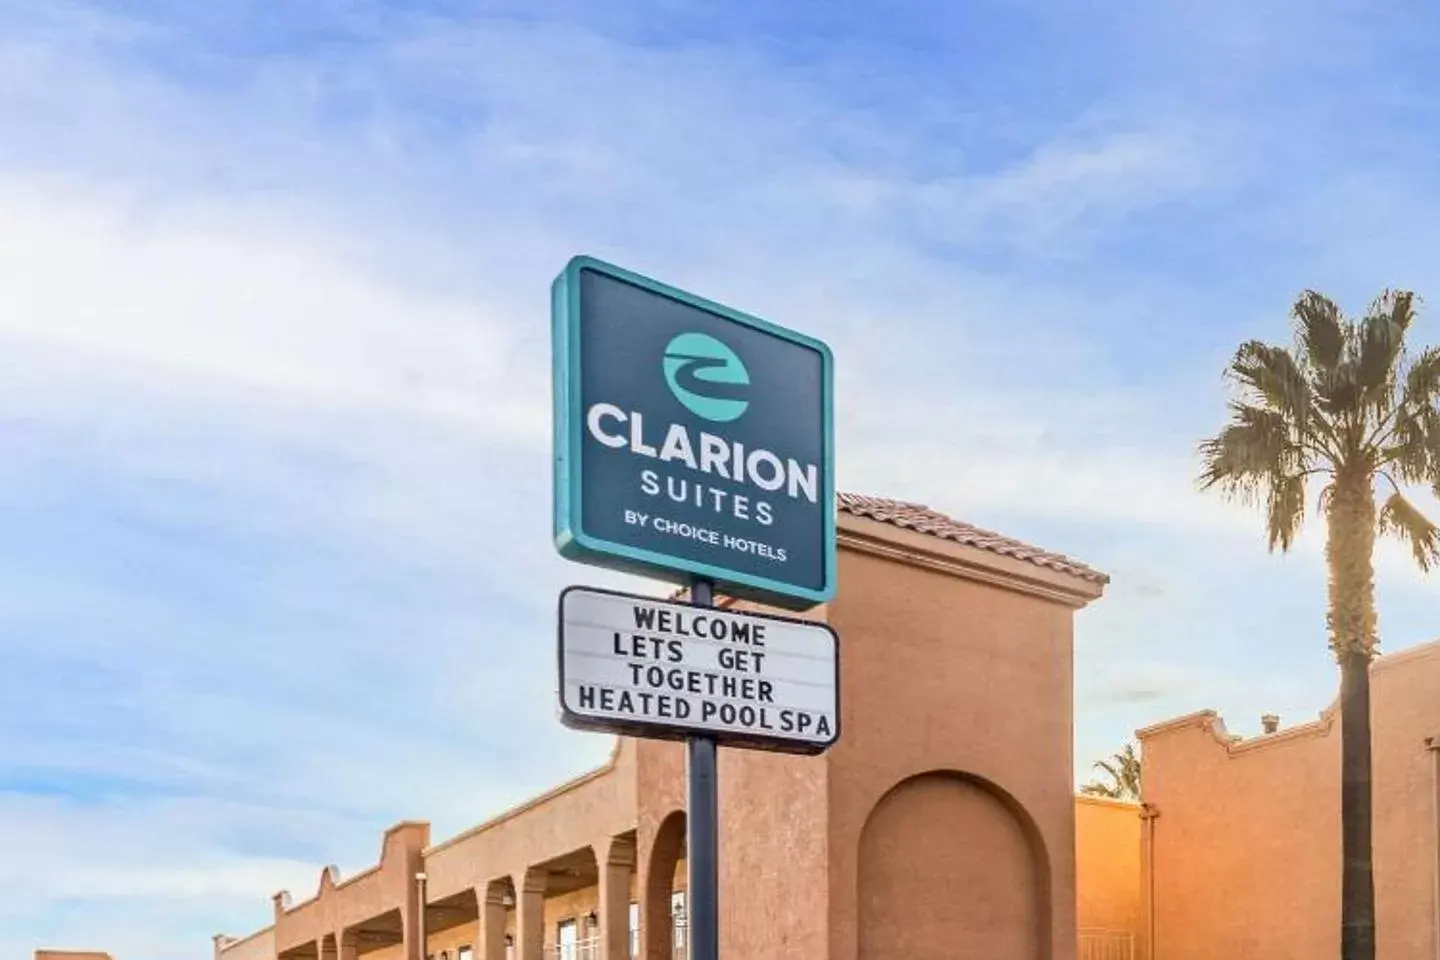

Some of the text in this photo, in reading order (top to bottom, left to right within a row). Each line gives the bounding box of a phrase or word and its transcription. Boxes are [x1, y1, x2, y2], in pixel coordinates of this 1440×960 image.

[587, 402, 818, 503] CLARION
[640, 470, 773, 525] SUITES
[624, 509, 788, 562] BY CHOICE HOTELS
[633, 606, 766, 647] WELCOME
[613, 633, 765, 674] LETS GET
[628, 663, 774, 703] TOGETHER
[579, 686, 831, 736] HEATED POOL SPA
